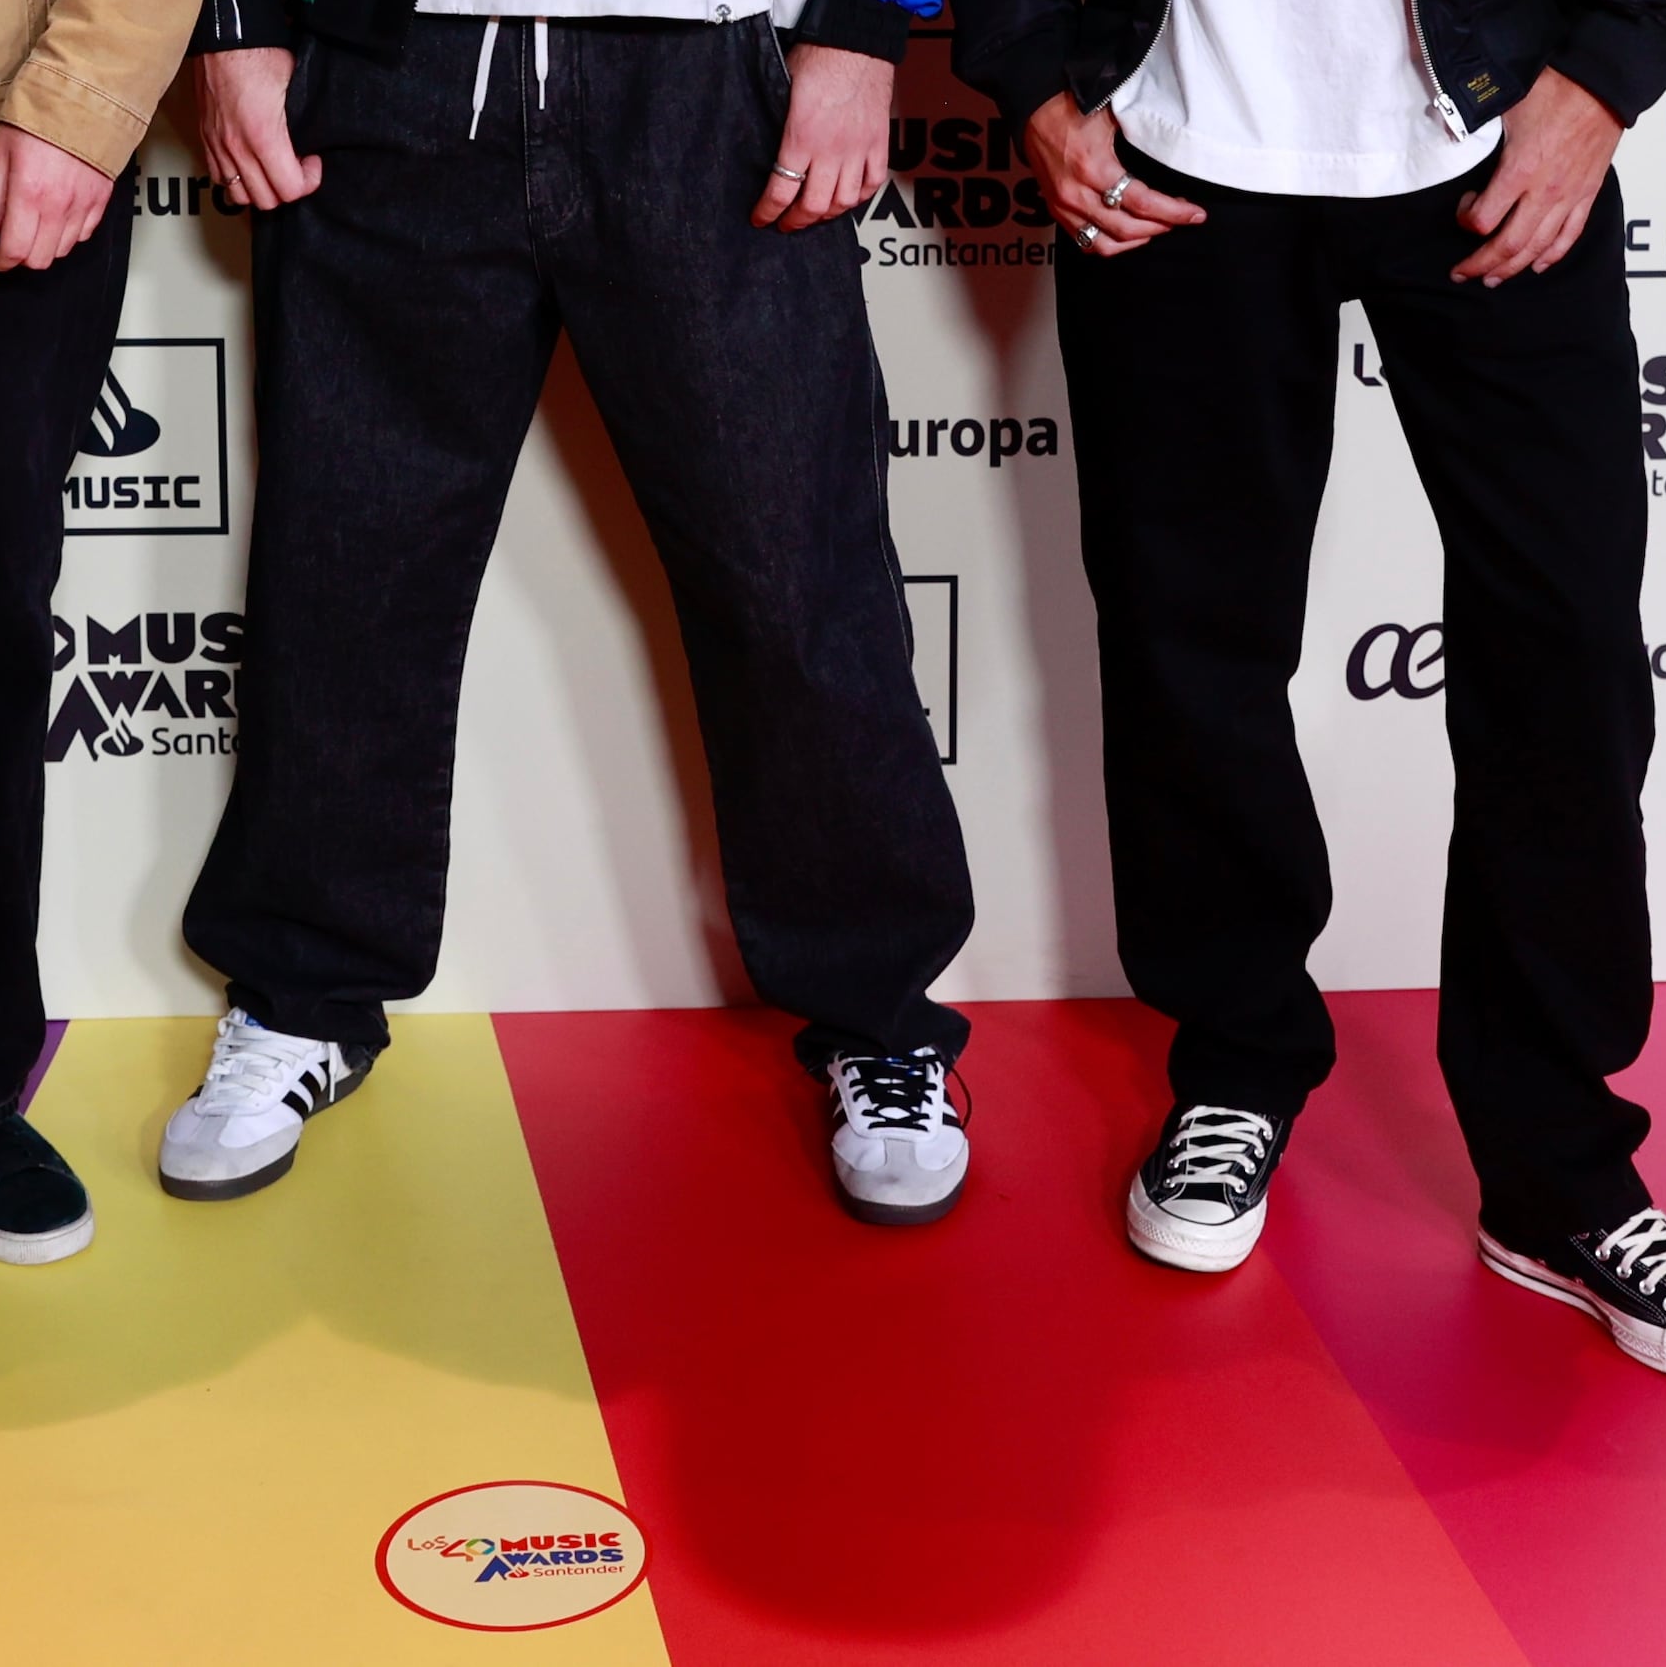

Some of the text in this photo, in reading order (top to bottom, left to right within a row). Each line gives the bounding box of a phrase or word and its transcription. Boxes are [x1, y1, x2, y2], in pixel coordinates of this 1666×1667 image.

[888, 117, 1031, 172] USI
[870, 177, 1057, 229] ARDS
[879, 237, 1055, 266] Santander
[889, 418, 1058, 467] uropa
[63, 475, 201, 509] MUSIC
[87, 612, 243, 664] MUS
[44, 669, 237, 762] AWAR
[500, 1532, 622, 1552] MUSIC
[474, 1548, 624, 1583] AWARDS
[534, 1565, 626, 1577] Santander
